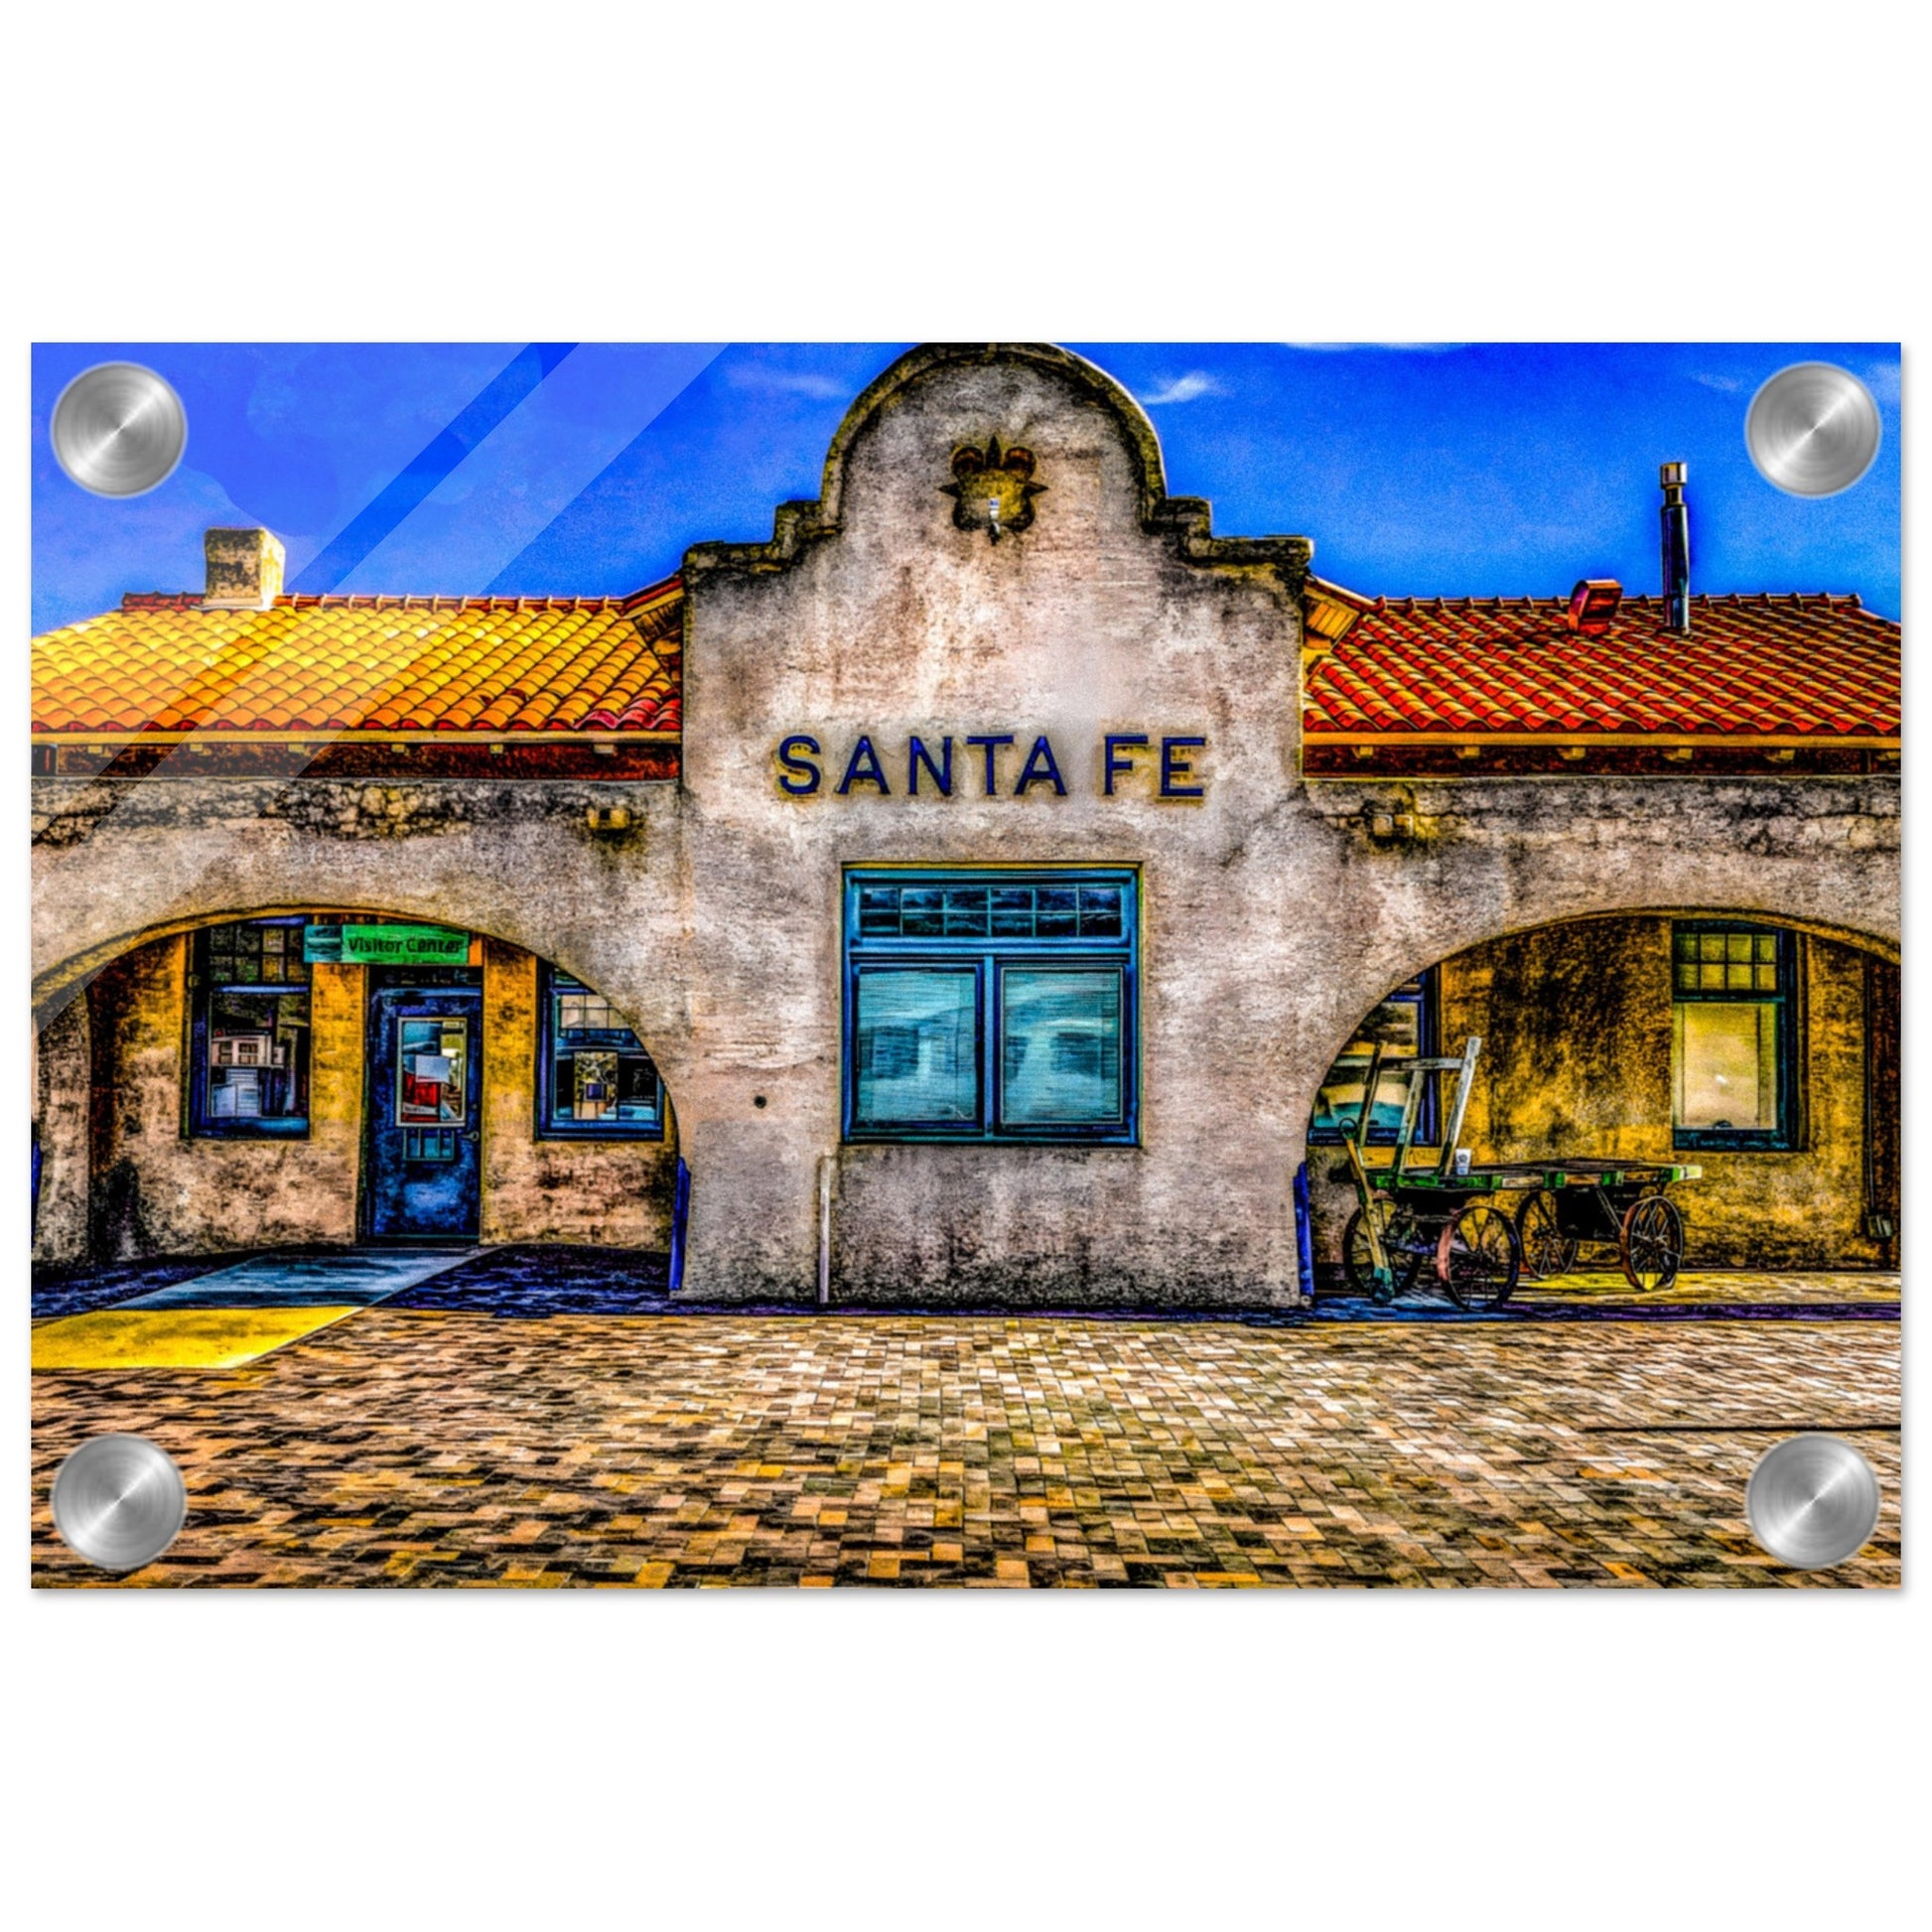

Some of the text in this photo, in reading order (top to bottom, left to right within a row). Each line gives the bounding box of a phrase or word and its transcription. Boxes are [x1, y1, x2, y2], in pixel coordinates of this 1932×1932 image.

[777, 733, 1206, 797] SANTA FE
[347, 936, 465, 954] Visitor Center
